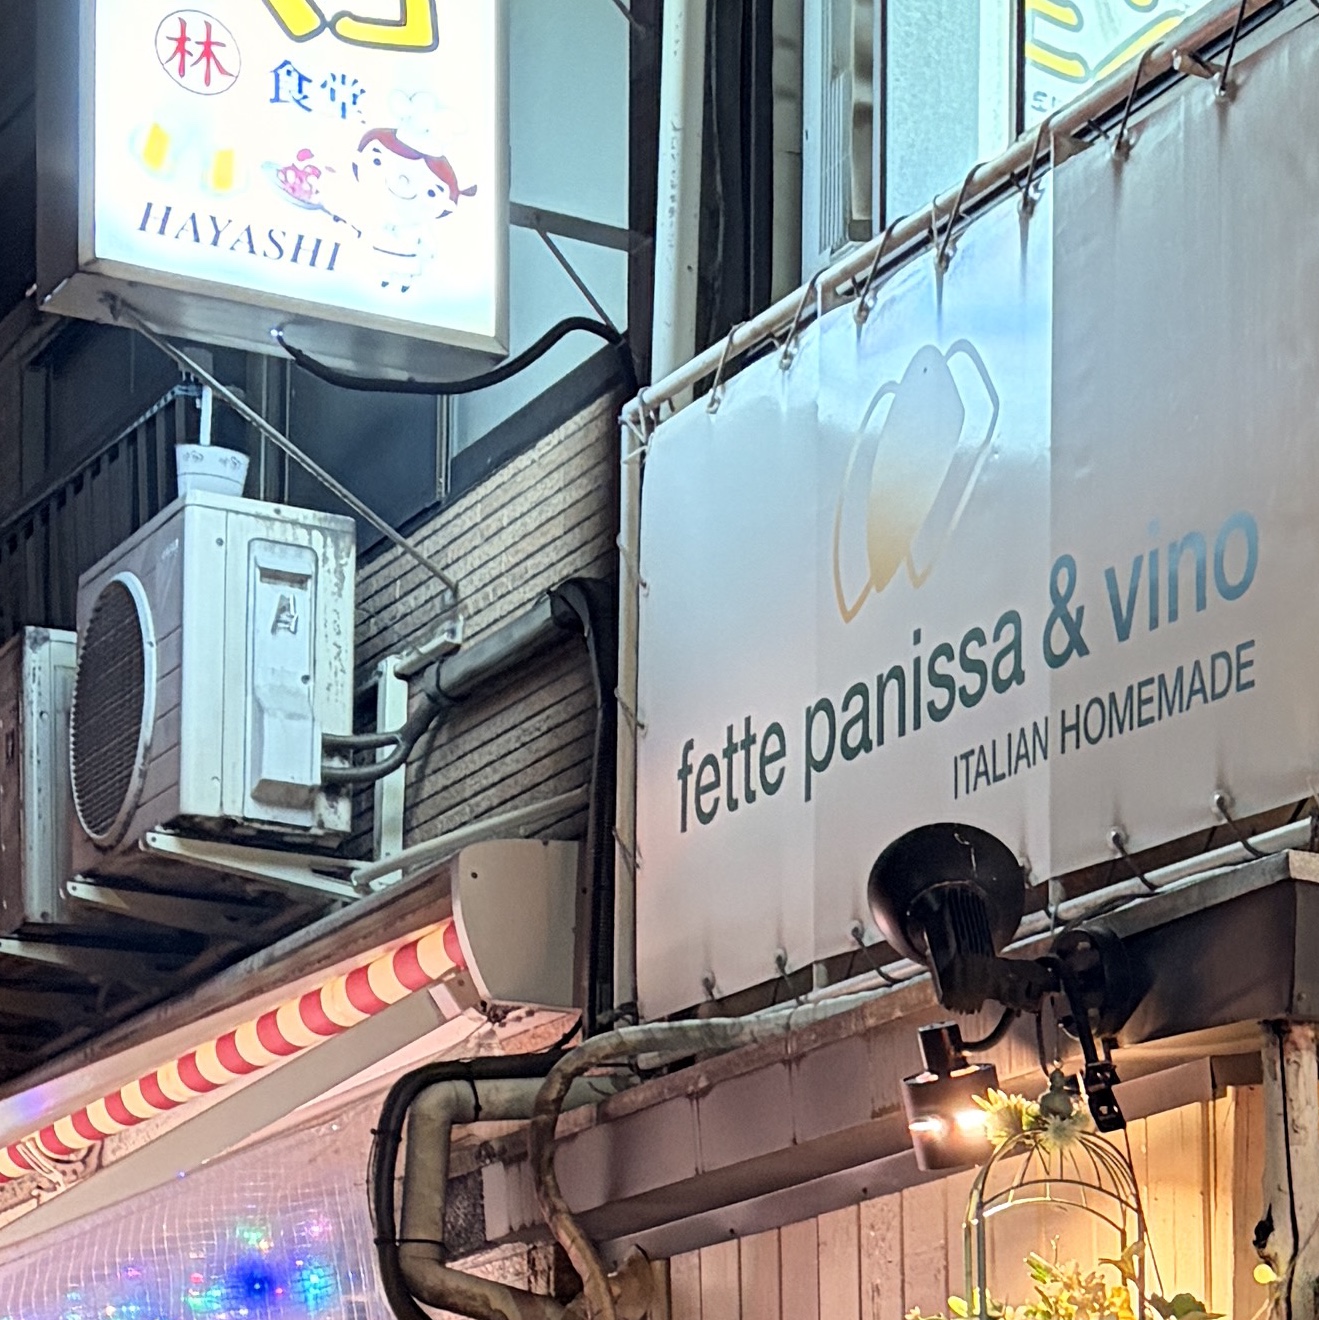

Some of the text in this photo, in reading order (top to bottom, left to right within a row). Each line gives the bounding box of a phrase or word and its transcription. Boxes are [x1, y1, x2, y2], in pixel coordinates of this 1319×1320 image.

[164, 17, 236, 88] 林
[137, 201, 341, 272] HAYASHI
[676, 511, 1261, 834] fette panissa & vino
[952, 638, 1257, 801] ITALIAN HOMEMADE
